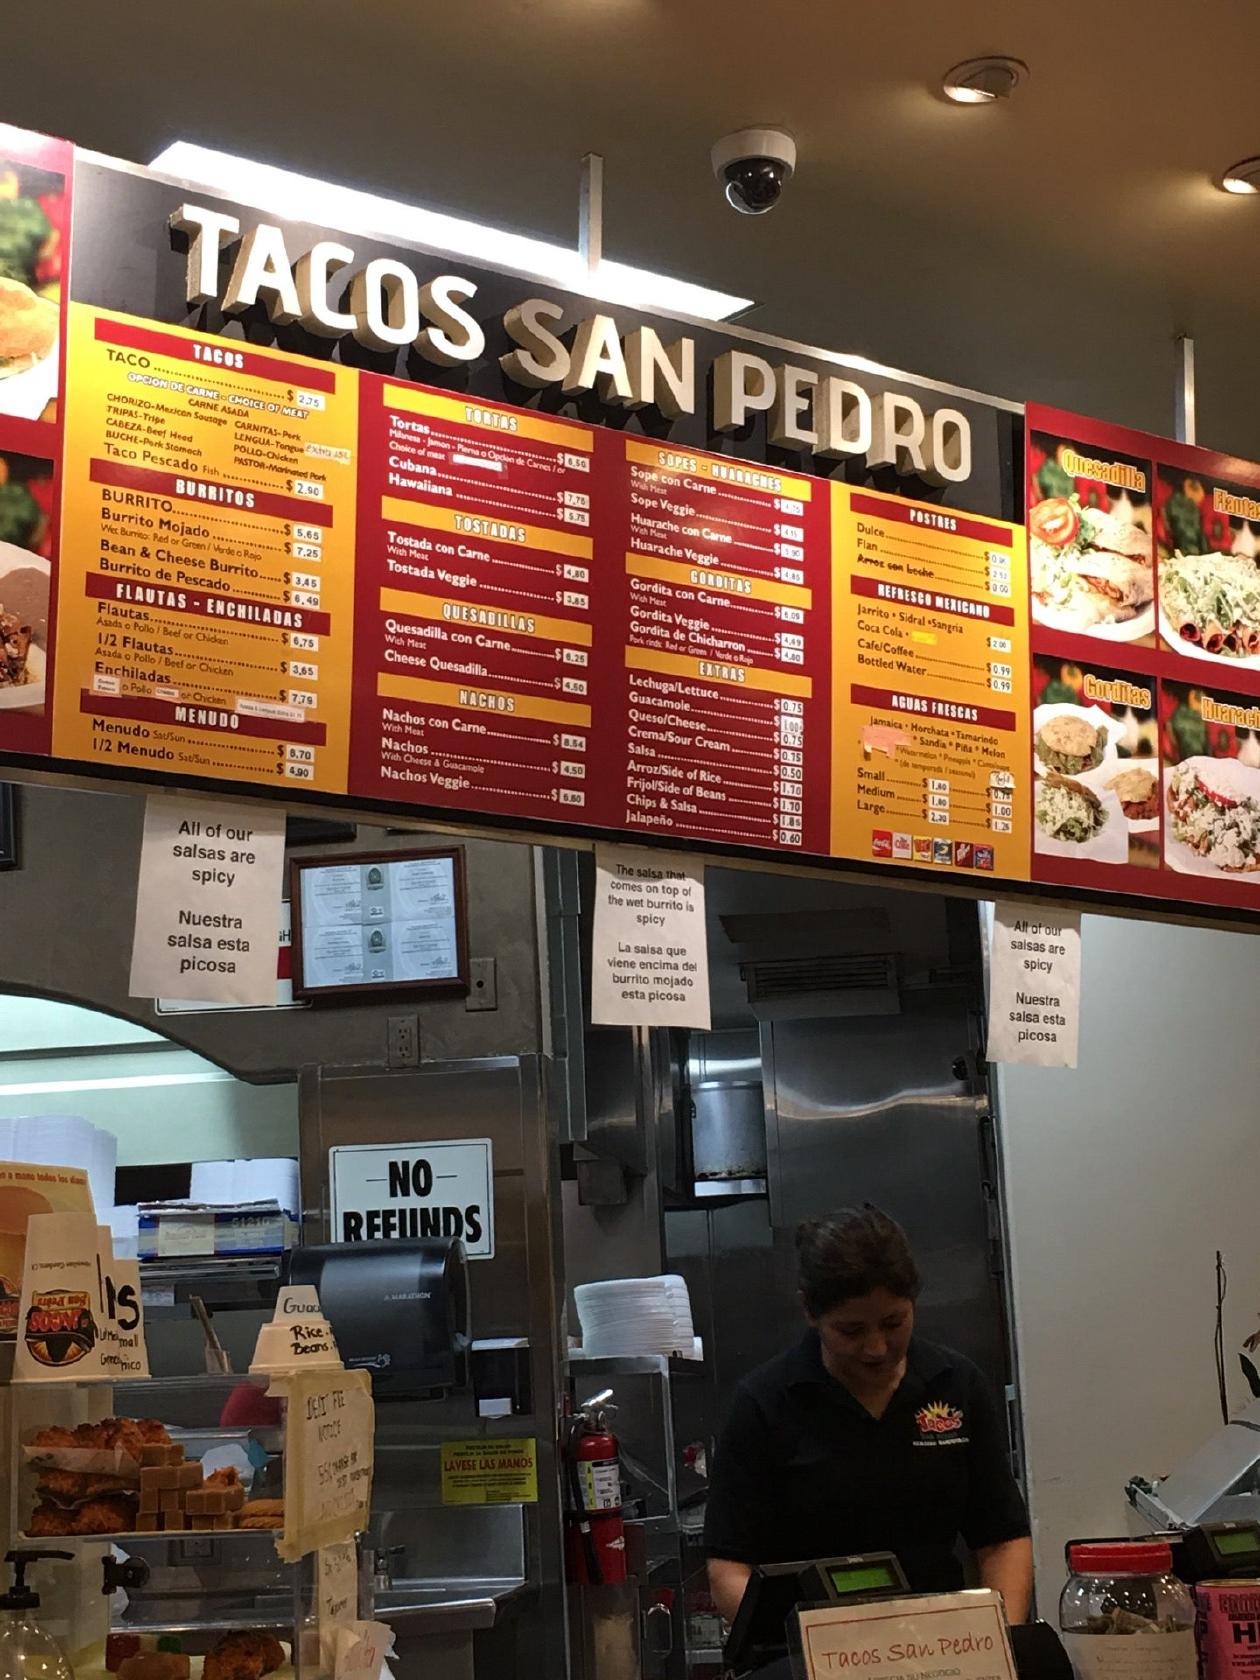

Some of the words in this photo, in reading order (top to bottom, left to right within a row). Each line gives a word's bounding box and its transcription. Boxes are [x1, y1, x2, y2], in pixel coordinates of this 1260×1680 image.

[171, 204, 486, 367] TACOS
[499, 298, 698, 419] SAN
[713, 349, 973, 489] PEDRO
[193, 344, 244, 368] TACOS
[107, 349, 150, 368] TACO
[188, 399, 219, 412] CARNE
[221, 405, 249, 418] ASADA
[465, 406, 517, 431] TORTAS
[390, 415, 430, 435] Tortas
[104, 443, 138, 459] Taco
[143, 451, 198, 472] Pescado
[389, 456, 437, 476] Cubana
[631, 466, 658, 482] Sope
[662, 475, 680, 487] con
[684, 479, 717, 495] Carne
[658, 452, 697, 472] SOPES
[712, 464, 782, 492] HUARACHES
[1062, 448, 1146, 492] Quesadilla
[176, 479, 254, 508] BURRITOS
[389, 473, 453, 496] Hawaiiana
[102, 489, 172, 513] BURRITO
[101, 507, 153, 527] Burrito
[159, 518, 210, 538] Mojado
[455, 515, 526, 542] TOSTADAS
[857, 522, 885, 538] Dulce
[910, 509, 957, 531] POSTRES
[387, 531, 432, 551] Tostada
[436, 543, 454, 555] con
[458, 546, 490, 562] Carne
[857, 538, 878, 551] Flan
[101, 540, 135, 556] Bean
[140, 547, 150, 557] &
[156, 549, 206, 568] Cheese
[210, 559, 259, 578] Burrito
[100, 558, 150, 577] Burrito
[156, 568, 171, 581] de
[177, 572, 230, 592] Pescado
[387, 560, 435, 579] Tostada
[437, 569, 477, 588] Veggie
[690, 570, 751, 593] GORDITAS
[98, 602, 150, 621] Flautas
[116, 584, 186, 608] FLAUTAS
[207, 599, 302, 628] ENCHILADAS
[878, 583, 932, 606] REFRESCO
[936, 596, 990, 618] MEXICANO
[442, 603, 535, 633] QUESADILLAS
[857, 604, 889, 619] Jarrito
[899, 612, 925, 626] Sidral
[385, 619, 447, 641] Quesadilla
[451, 632, 472, 644] con
[475, 635, 511, 651] Carne
[630, 621, 670, 640] Gordita
[673, 629, 685, 641] de
[689, 632, 745, 651] Chicharron
[857, 620, 880, 633] Coca
[883, 625, 903, 638] Cola
[98, 633, 117, 647] 1/2
[123, 637, 173, 655] Flautas
[858, 638, 914, 658] Cafe/Coffee
[95, 662, 171, 684] Enchiladas
[385, 650, 426, 667] Cheese
[430, 657, 488, 677] Quesadilla
[699, 662, 745, 682] EXTRAS
[858, 654, 894, 669] Bottled
[896, 661, 927, 676] Water
[629, 675, 719, 699] Lechuga/Lettuce
[1084, 674, 1151, 708] Gorditas
[459, 689, 515, 712] NACHOS
[629, 692, 690, 711] Guacamole
[892, 695, 928, 712] AGUAS
[932, 702, 978, 721] FRESCAS
[93, 719, 150, 738] Menudo
[175, 706, 239, 729] MENUDO
[382, 708, 425, 725] Nachos
[429, 716, 448, 729] con
[452, 719, 487, 734] Carne
[628, 709, 706, 731] Queso/Cheese
[870, 716, 902, 729] Jamaica
[911, 723, 949, 737] Horchata
[956, 730, 998, 745] Tamarindo
[93, 738, 112, 752] 1/2
[117, 741, 174, 760] Menudo
[381, 766, 427, 783] Nachos
[430, 773, 469, 790] Veggie
[627, 760, 684, 778] Arroz/Side
[687, 769, 697, 780] of
[700, 771, 722, 784] Rice
[857, 768, 885, 781] Small
[857, 784, 895, 798] Medium
[626, 810, 674, 826] Jalapeño
[857, 800, 885, 815] Large
[178, 820, 200, 836] All
[206, 824, 221, 839] of
[227, 827, 252, 842] our
[173, 845, 225, 860] salsas
[230, 850, 256, 864] are
[192, 868, 235, 887] spicy
[617, 864, 634, 876] The
[637, 868, 663, 879] salsa
[666, 871, 685, 881] that
[611, 881, 642, 892] comes
[646, 886, 658, 894] on
[662, 886, 678, 897] top
[682, 887, 691, 896] of
[608, 895, 624, 905] the
[627, 898, 644, 908] wet
[647, 898, 683, 911] burrito
[686, 903, 694, 912] is
[178, 910, 243, 929] Nuestra
[636, 914, 665, 927] spicy
[1014, 921, 1028, 932] All
[1032, 923, 1041, 934] of
[1045, 927, 1062, 936] our
[168, 933, 212, 950] salsa
[217, 938, 249, 952] esta
[618, 942, 631, 953] La
[634, 944, 663, 954] salsa
[666, 946, 687, 957] que
[1011, 940, 1045, 952] salsas
[1048, 944, 1066, 955] are
[180, 958, 236, 974] picosa
[608, 959, 636, 969] viene
[639, 962, 678, 971] encima
[682, 961, 697, 971] del
[1024, 959, 1053, 973] spicy
[613, 974, 649, 984] burrito
[653, 976, 693, 987] mojado
[622, 990, 645, 1000] esta
[649, 991, 685, 1002] picosa
[1016, 992, 1060, 1006] Nuestra
[1009, 1012, 1039, 1023] salsa
[1043, 1013, 1066, 1025] esta
[1018, 1029, 1056, 1042] picosa
[389, 1159, 432, 1198] NO
[290, 1325, 324, 1340] Rice
[444, 1459, 477, 1471] LAVESE
[479, 1459, 495, 1470] LAS
[497, 1457, 533, 1469] MANOS
[822, 1649, 881, 1669] Tacos
[887, 1642, 933, 1662] San
[938, 1632, 993, 1654] Pedro
